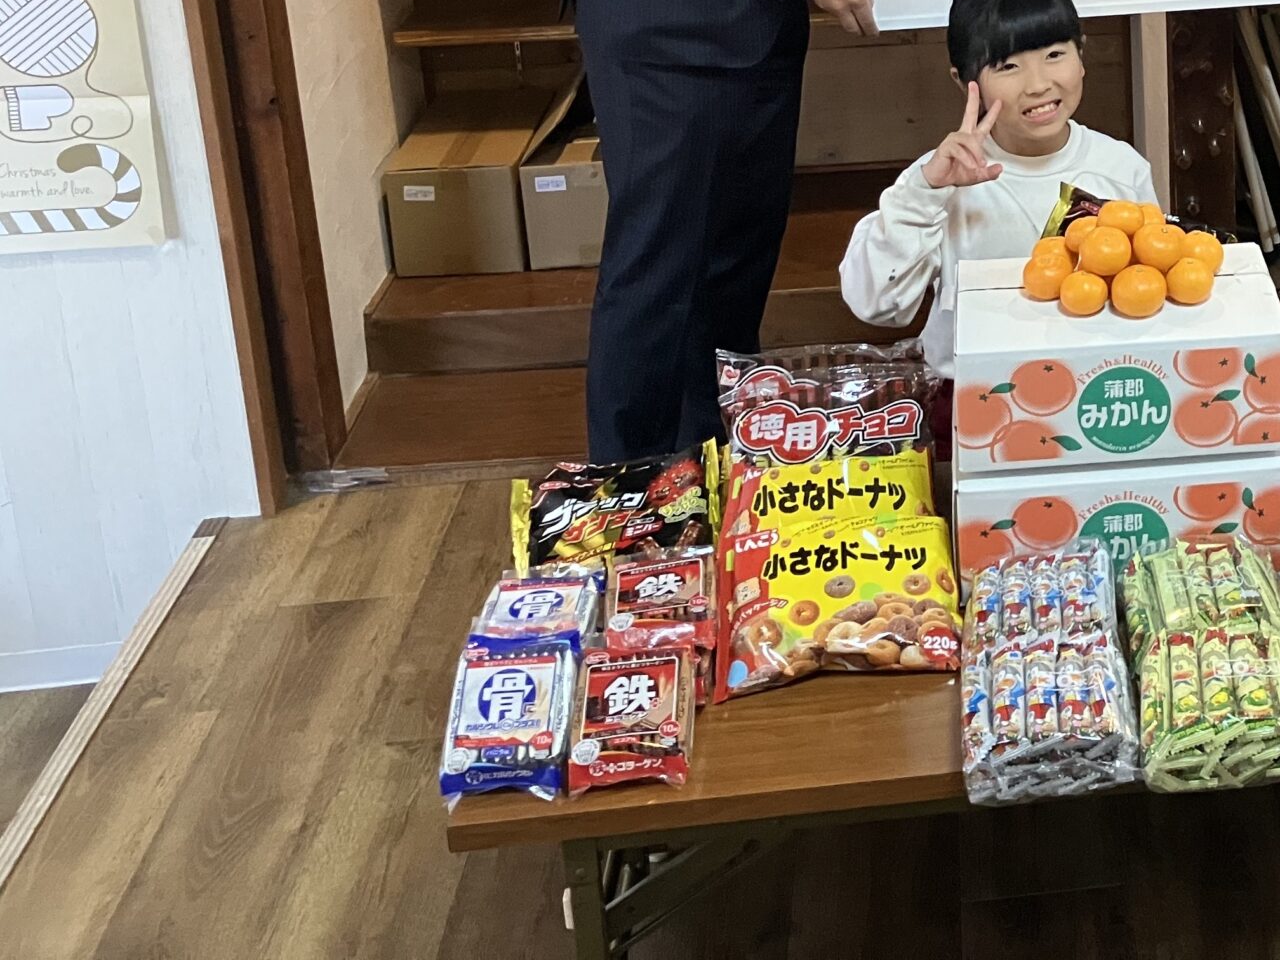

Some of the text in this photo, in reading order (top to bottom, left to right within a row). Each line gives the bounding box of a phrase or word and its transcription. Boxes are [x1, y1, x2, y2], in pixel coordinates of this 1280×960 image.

[1104, 378, 1144, 398] 蒲郡
[1081, 400, 1168, 429] みかん
[753, 477, 906, 517] 小さなドーナツ
[1104, 513, 1143, 533] 蒲郡
[763, 541, 927, 579] 小さなドーナツ
[635, 573, 683, 598] 鉄
[514, 592, 561, 619] 骨
[483, 672, 535, 722] 骨
[604, 674, 656, 715] 鉄
